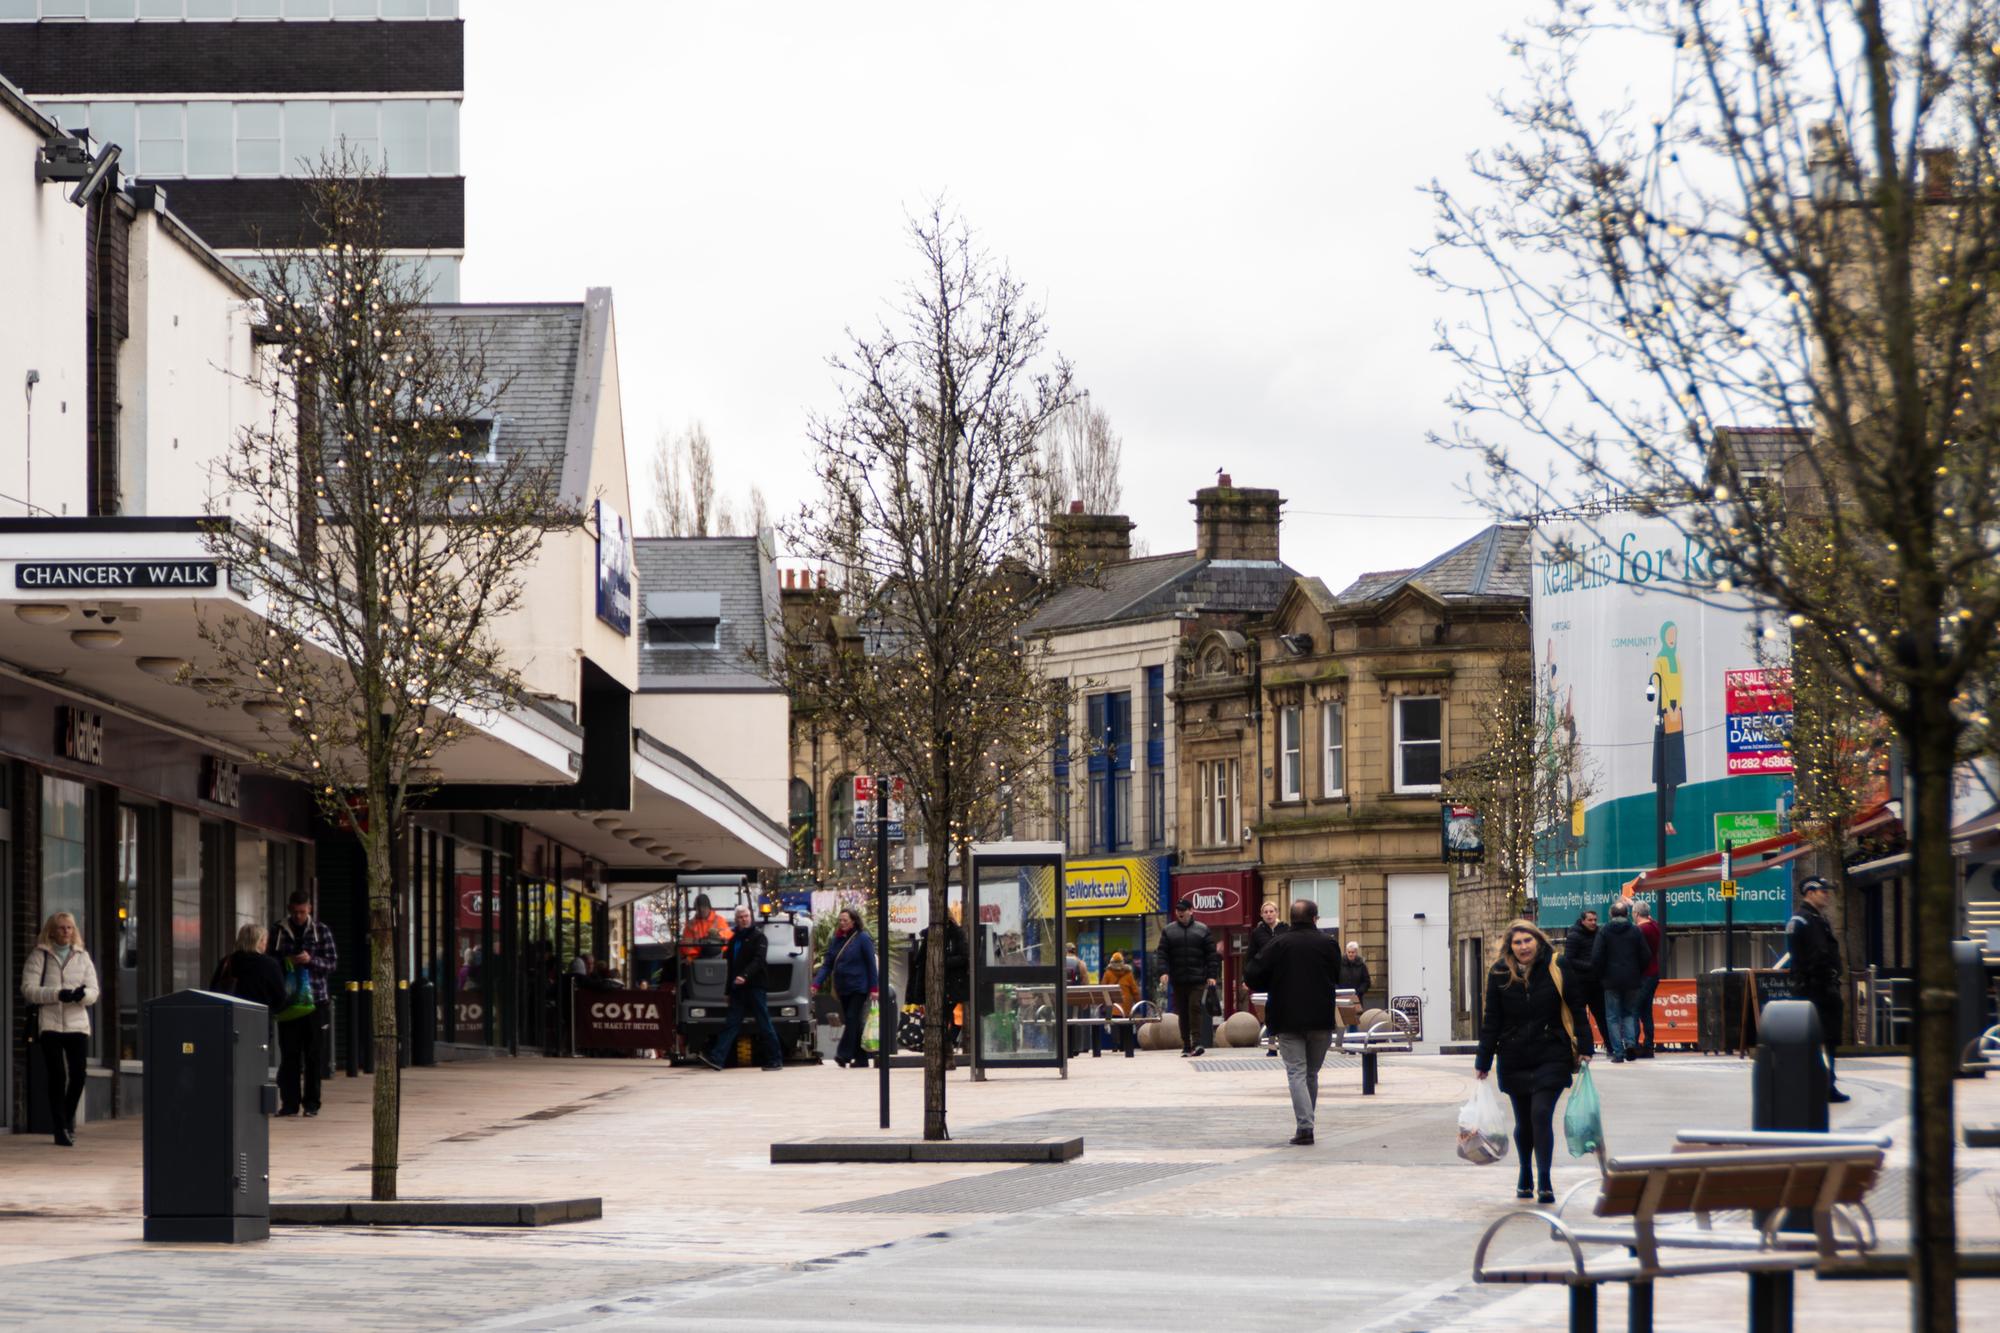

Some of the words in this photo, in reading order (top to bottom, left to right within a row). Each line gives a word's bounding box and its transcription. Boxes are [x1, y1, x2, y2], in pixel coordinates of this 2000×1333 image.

[1616, 532, 1674, 584] for
[22, 566, 136, 585] CHANCERY
[147, 566, 209, 584] WALK
[1611, 636, 1657, 649] COMMUNITY
[1744, 672, 1765, 685] SALE
[1730, 728, 1786, 743] DAWS
[1729, 758, 1760, 770] 01282
[1665, 886, 1704, 907] agents,
[591, 1002, 660, 1020] COSTA
